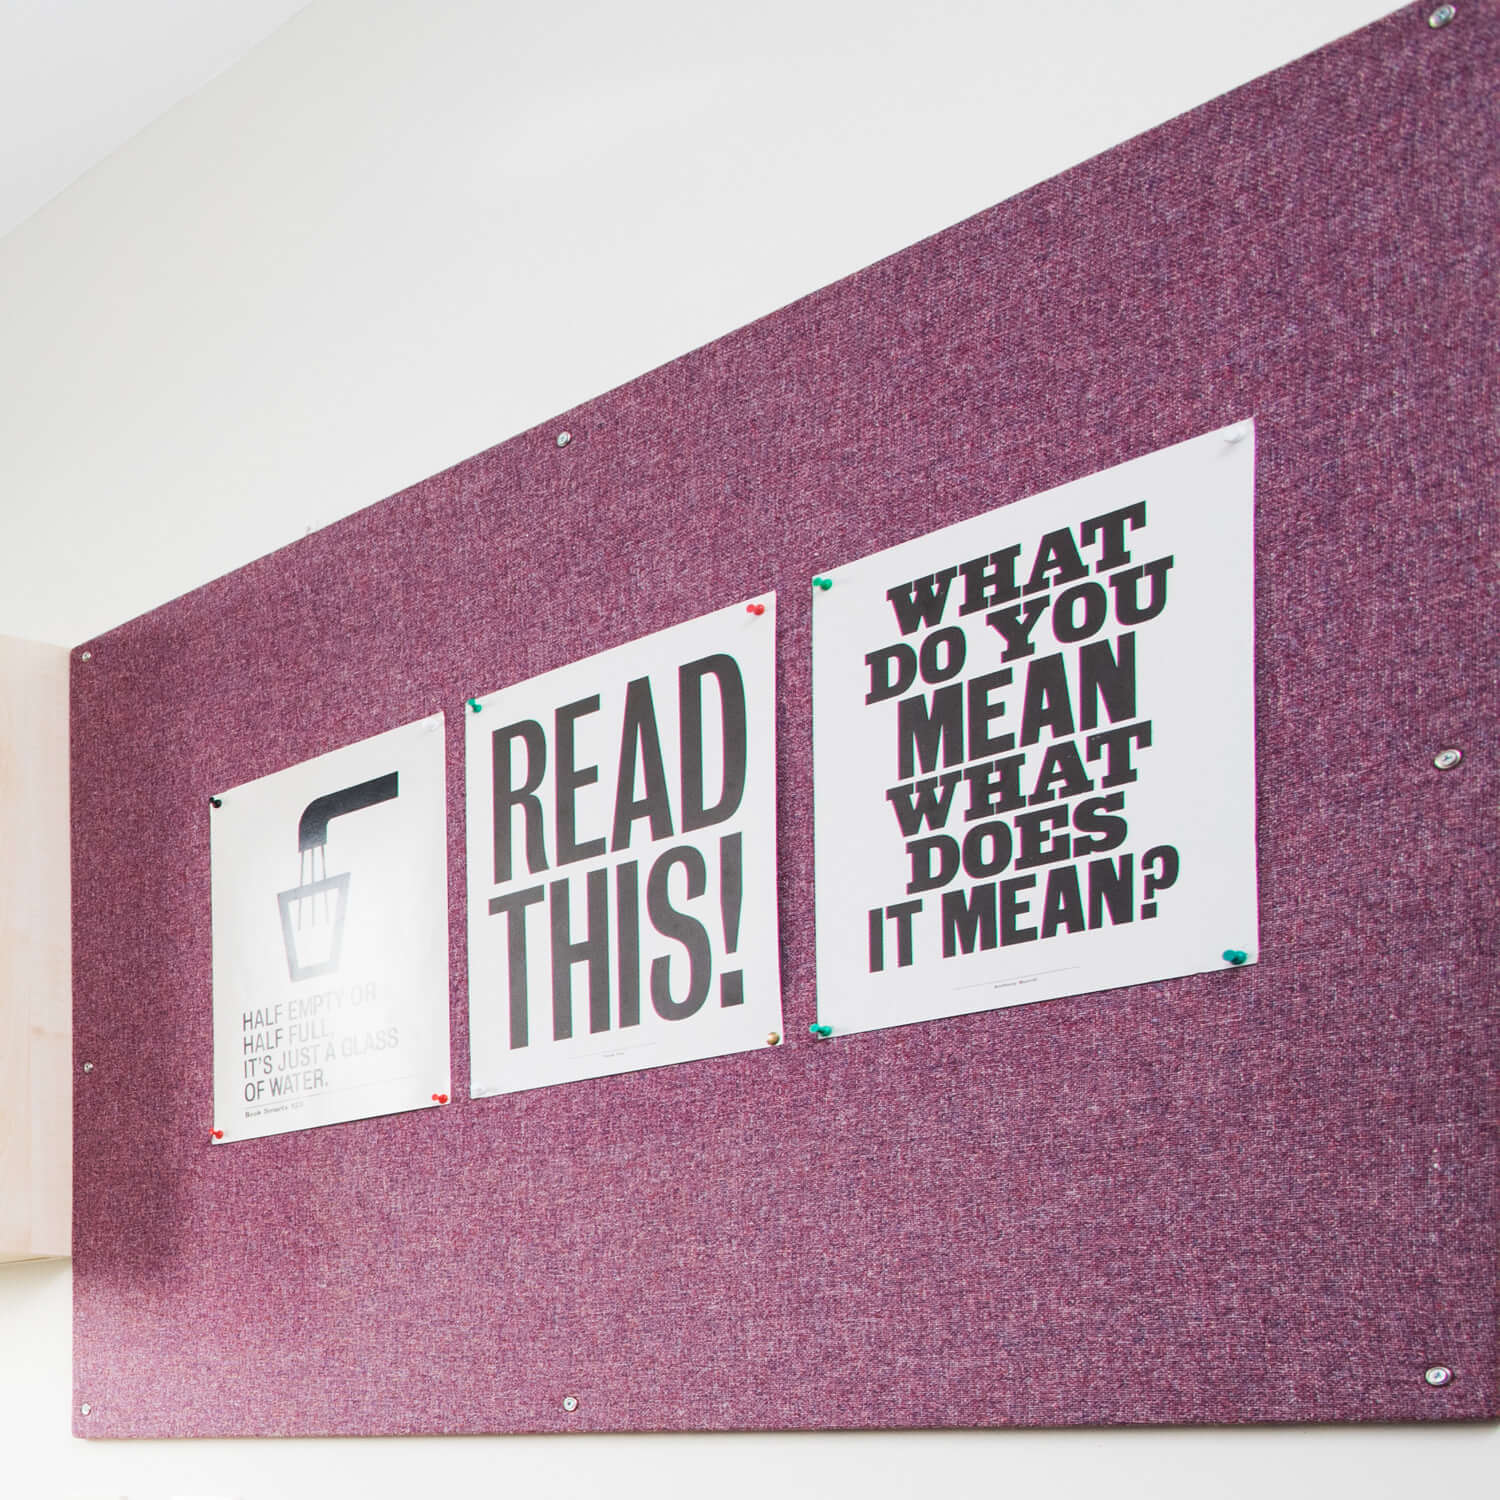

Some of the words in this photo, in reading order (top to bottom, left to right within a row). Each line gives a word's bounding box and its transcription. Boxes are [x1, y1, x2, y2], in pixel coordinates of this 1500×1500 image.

[865, 626, 967, 705] DO
[985, 555, 1174, 663] YOU
[887, 500, 1147, 637] WHAT
[897, 631, 1137, 781] MEAN
[492, 652, 747, 885] READ
[886, 720, 1153, 838] WHAT
[906, 791, 1128, 895] DOES
[489, 831, 744, 1050] THIS!
[868, 899, 923, 973] IT
[941, 844, 1180, 959] MEAN?
[242, 1003, 283, 1032] HALF
[288, 990, 344, 1021] EMPTY
[351, 981, 377, 1007] OR
[243, 1028, 284, 1056] HALF
[244, 1054, 273, 1079] IT'S
[278, 1044, 321, 1072] JUST
[324, 1040, 337, 1062] A
[341, 1026, 400, 1058] GLASS
[244, 1079, 265, 1102] OF
[268, 1068, 329, 1097] WATER.
